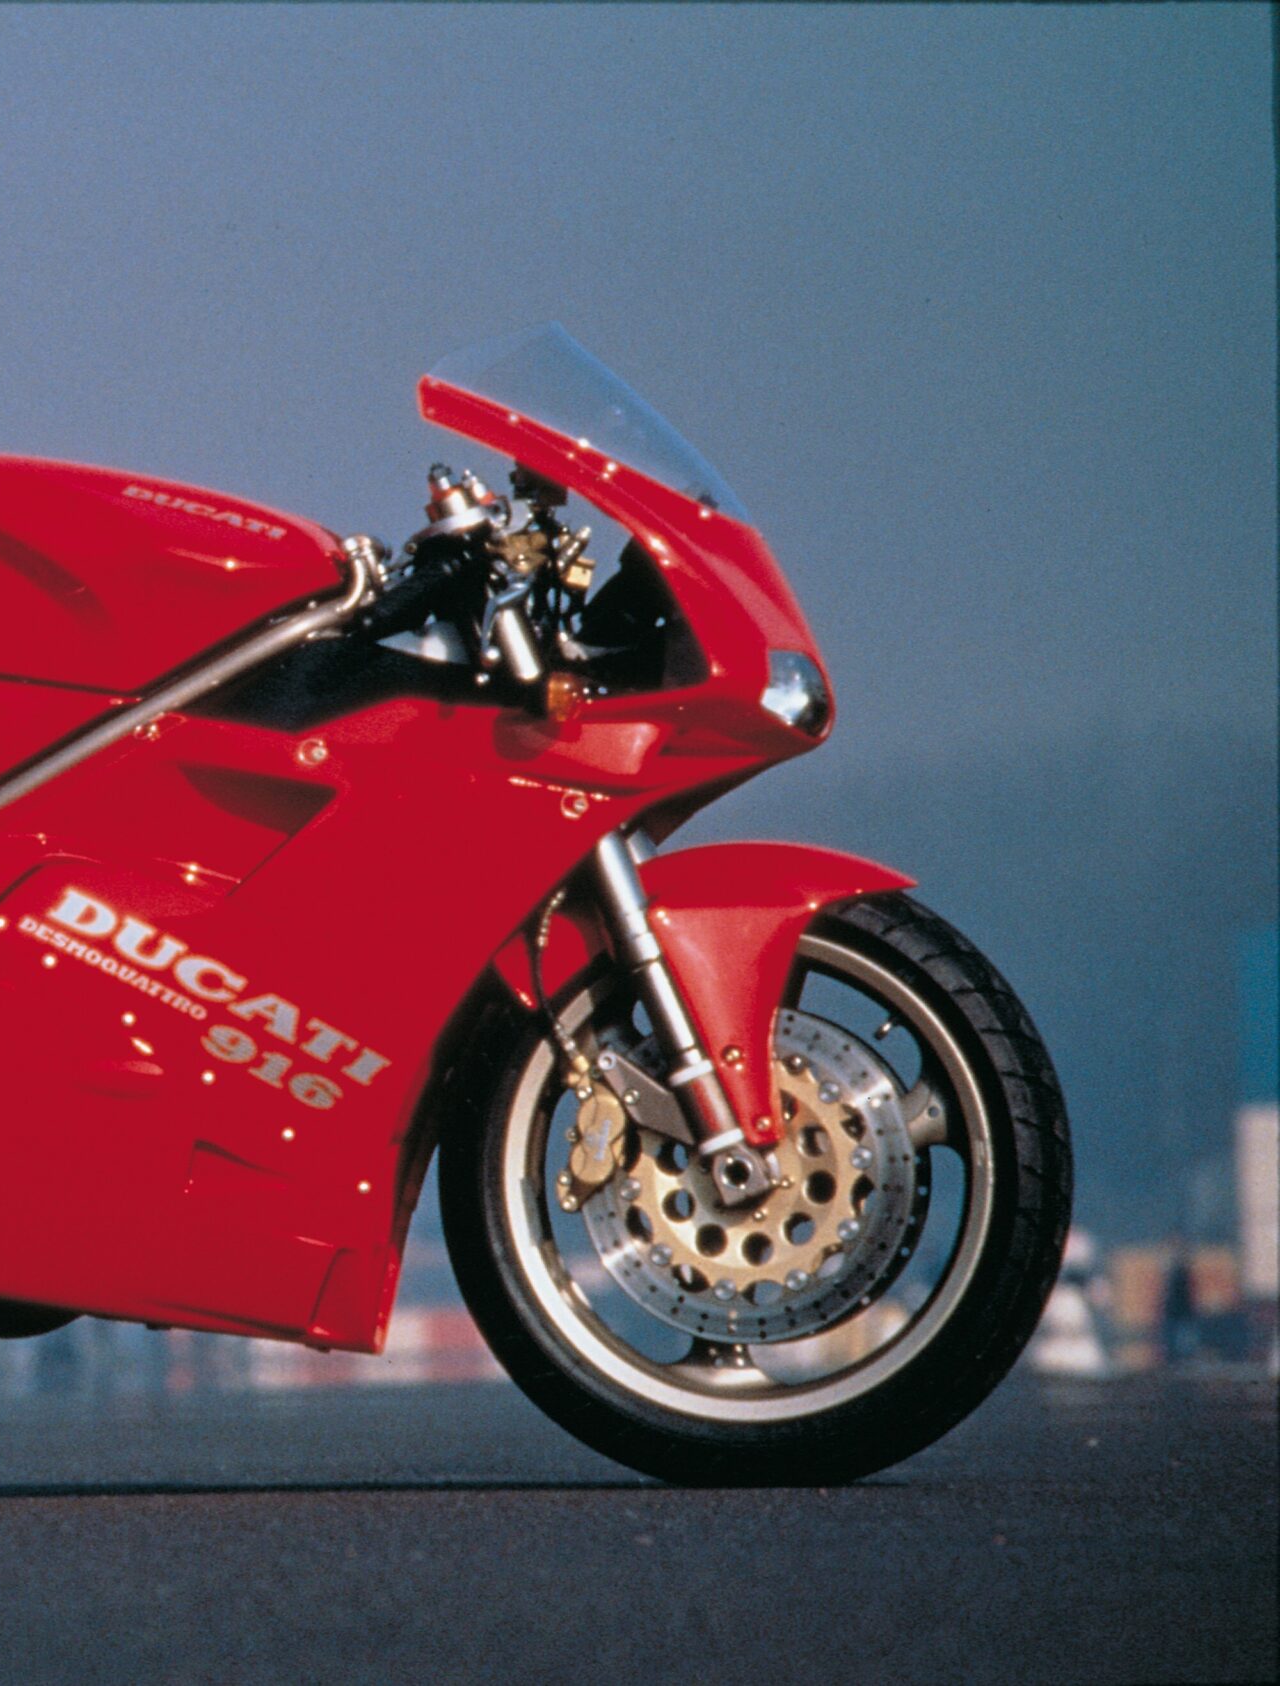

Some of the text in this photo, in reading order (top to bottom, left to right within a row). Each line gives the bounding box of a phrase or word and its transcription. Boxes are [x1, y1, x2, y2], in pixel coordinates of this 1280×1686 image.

[122, 485, 287, 540] DUCATI
[19, 917, 208, 1021] DESMOQUATTRO
[46, 886, 392, 1086] DUCATI
[200, 1024, 344, 1110] 916
